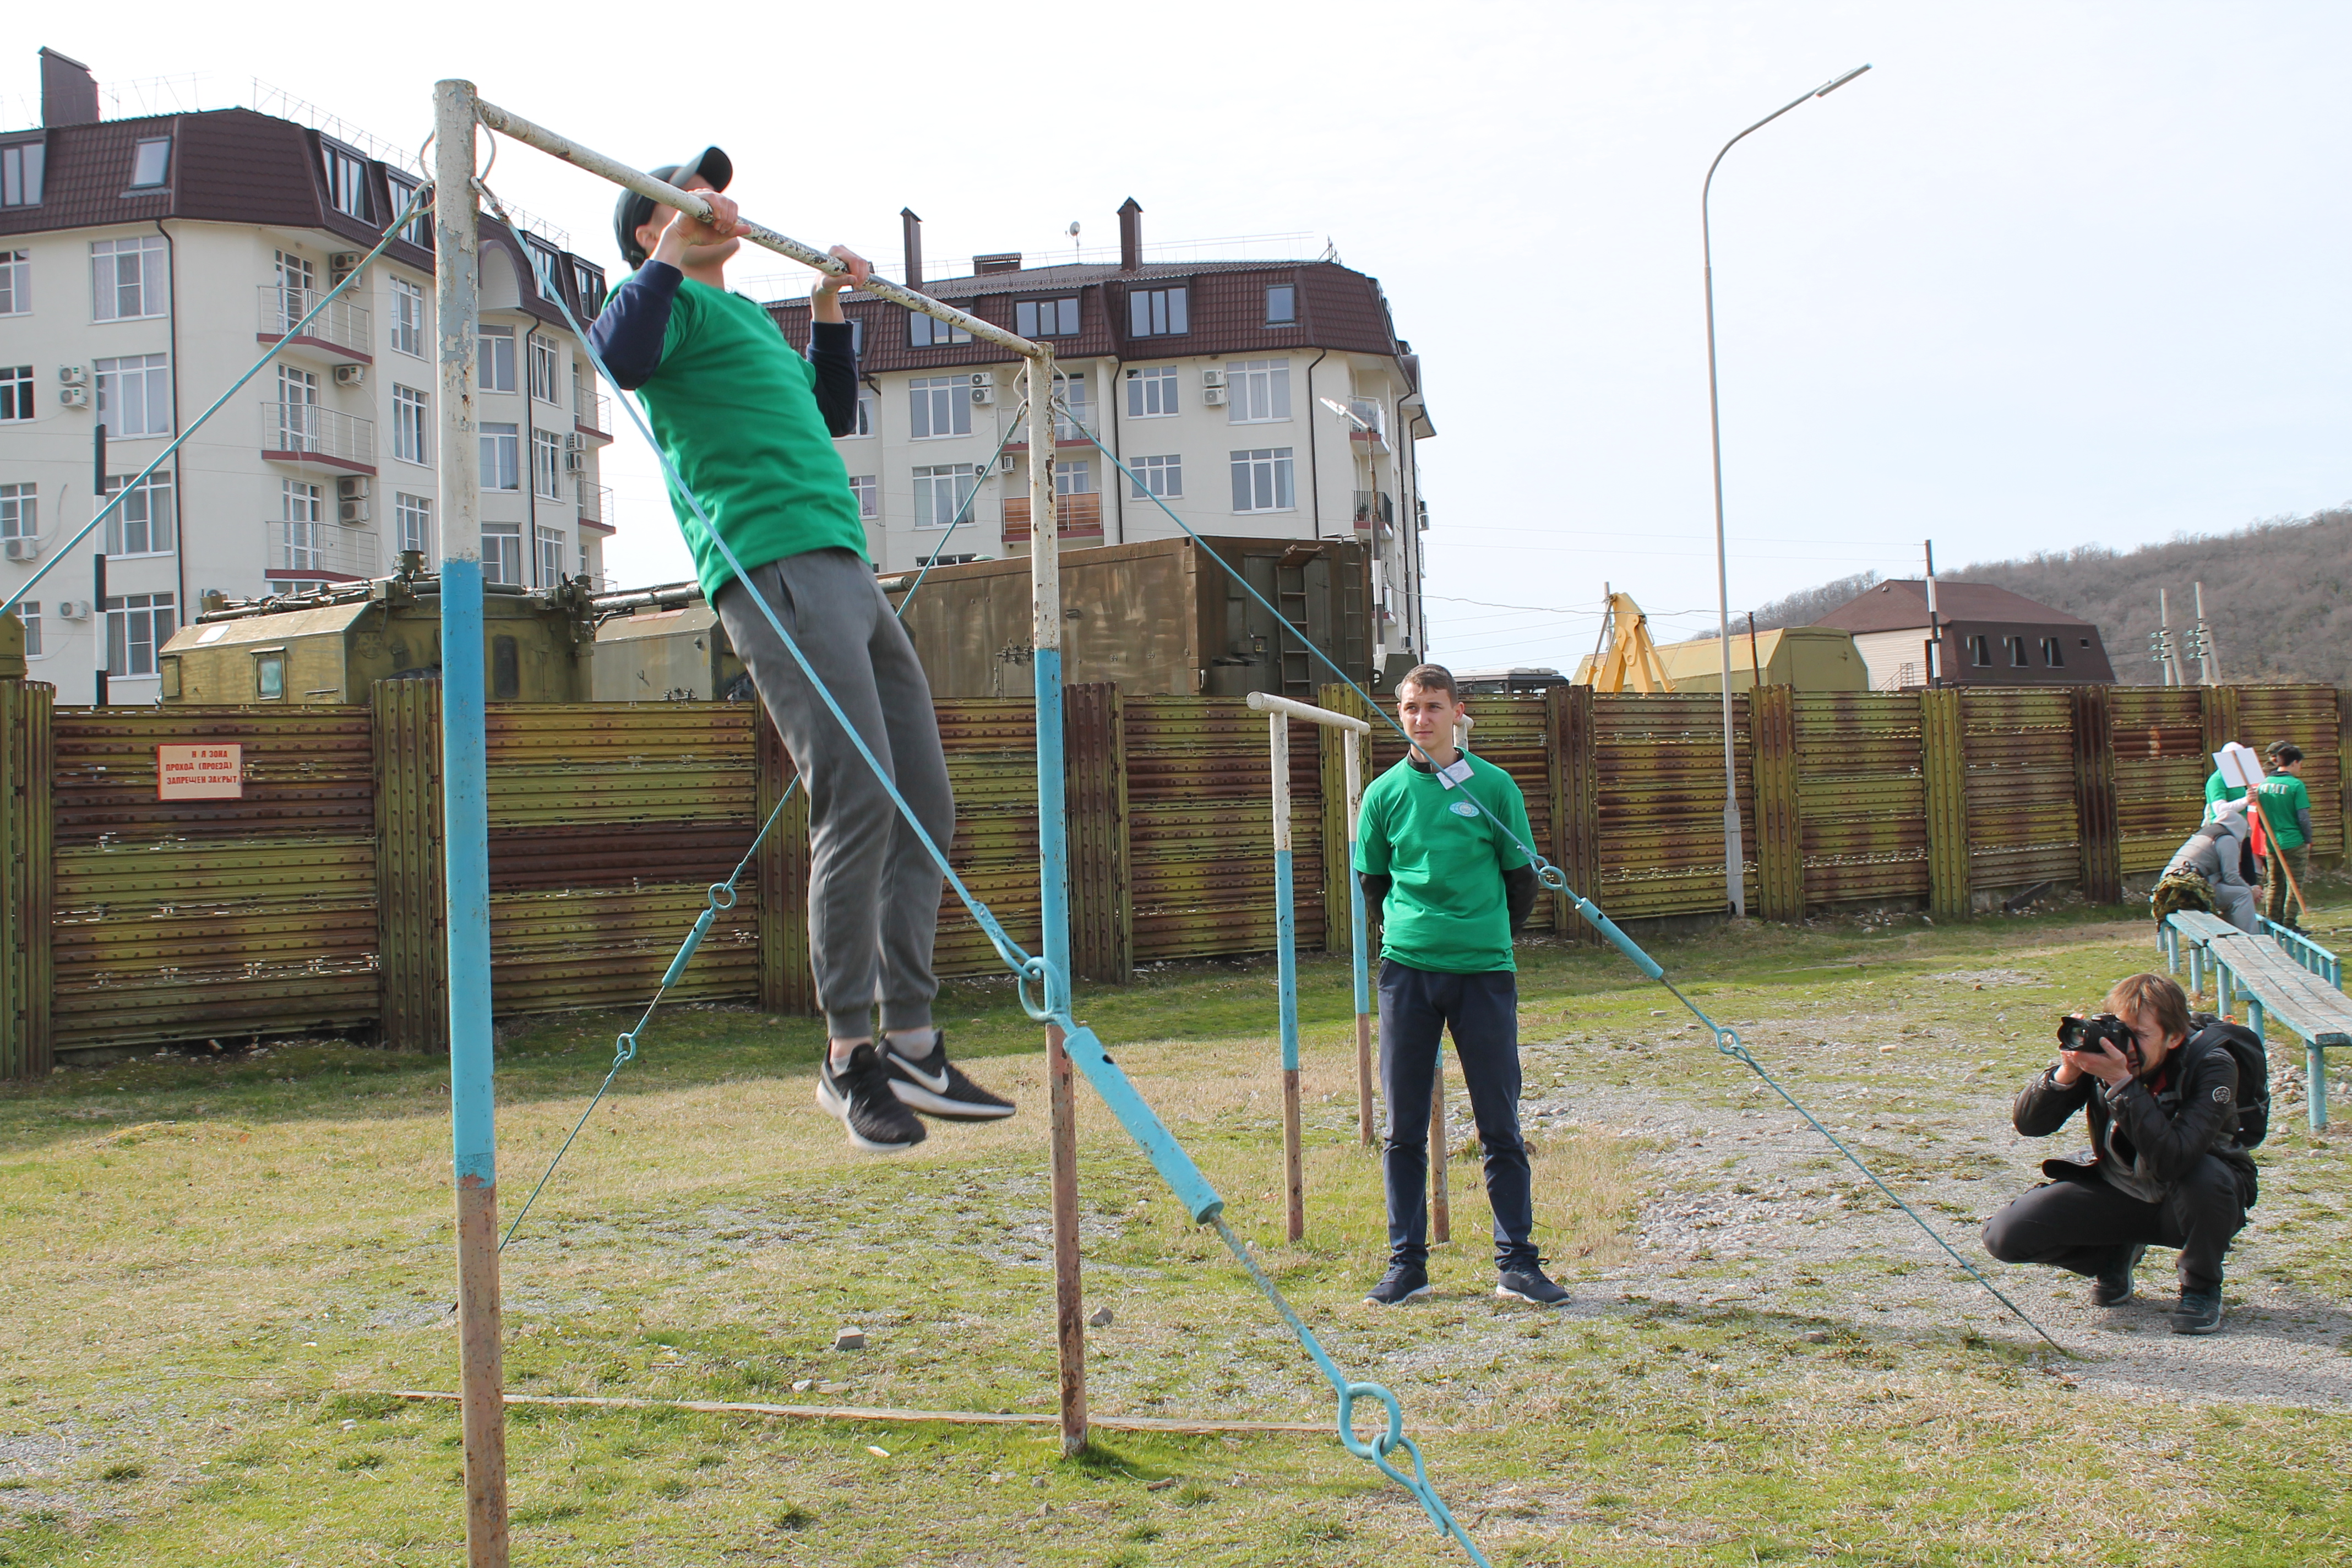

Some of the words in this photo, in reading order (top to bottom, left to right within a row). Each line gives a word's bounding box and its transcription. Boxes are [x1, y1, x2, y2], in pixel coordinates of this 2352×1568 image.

[166, 763, 194, 771] ПРОХОД
[199, 761, 232, 770] (ПРОЕЗД)
[167, 776, 206, 785] ЗАПРЕЩЕН
